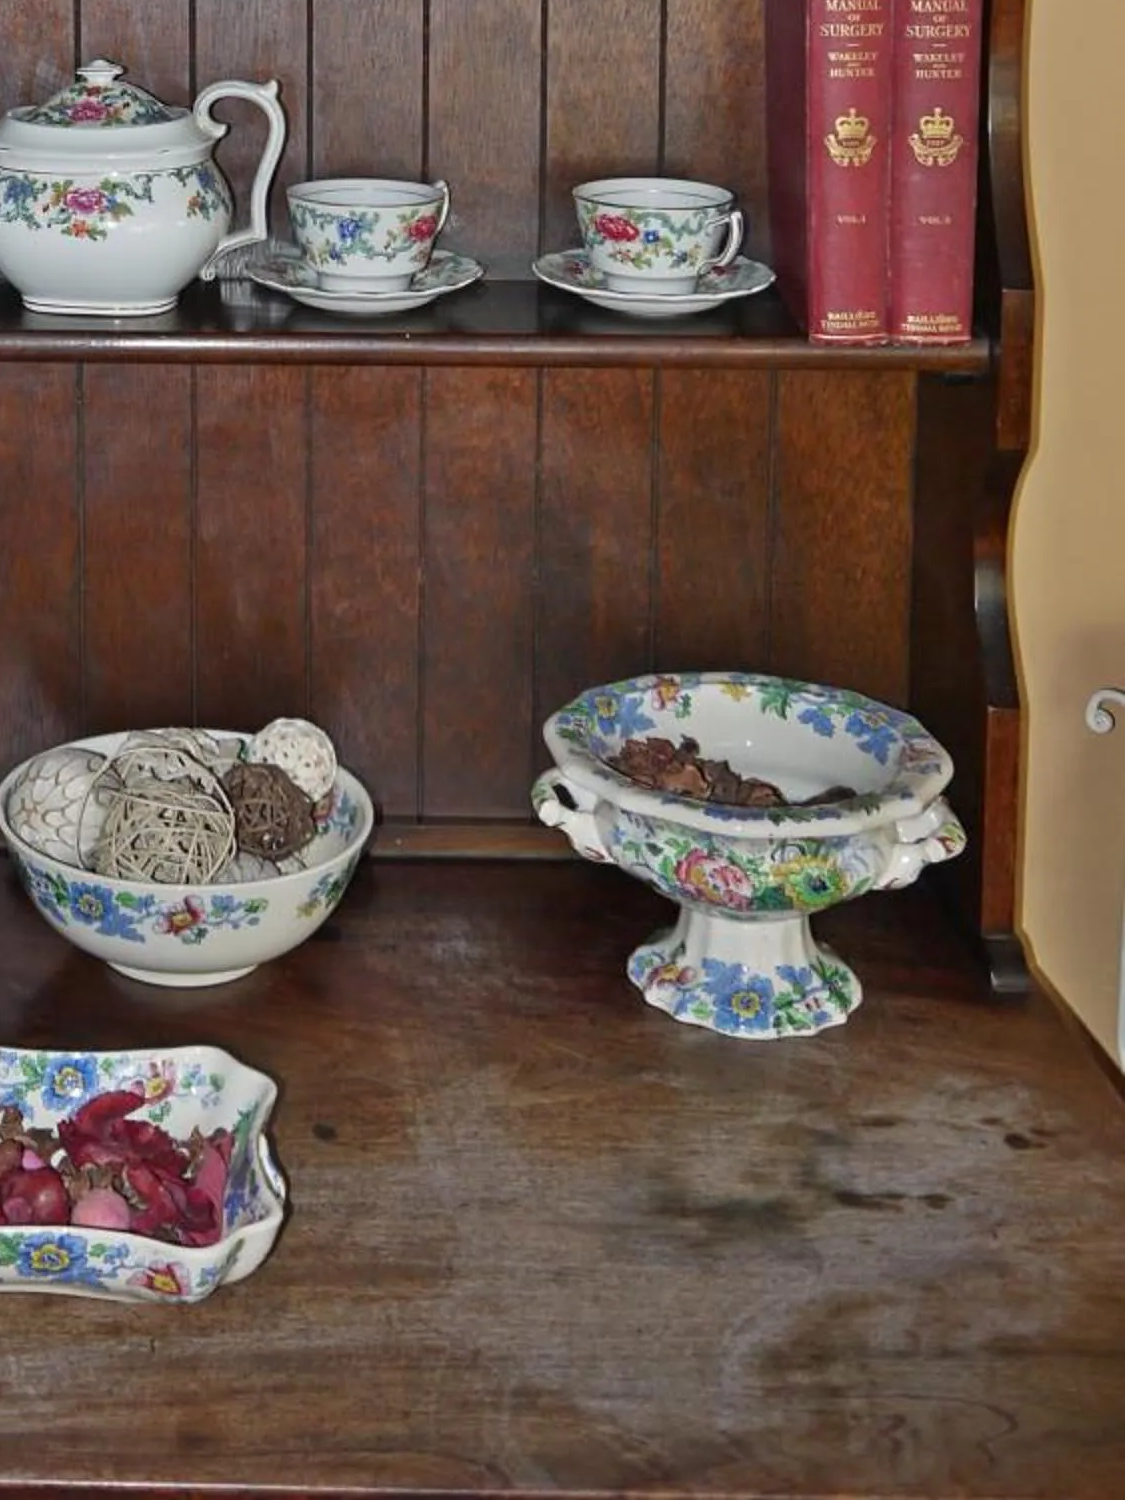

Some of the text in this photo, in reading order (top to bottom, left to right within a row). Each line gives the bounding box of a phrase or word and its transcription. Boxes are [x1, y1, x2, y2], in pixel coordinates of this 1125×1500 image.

[826, 0, 881, 11] MANUAL
[911, 0, 967, 12] MANUAL
[819, 24, 884, 37] SURGERY
[906, 25, 971, 37] SURGERY
[830, 68, 875, 77] HUNTER
[916, 69, 962, 79] HUNTER
